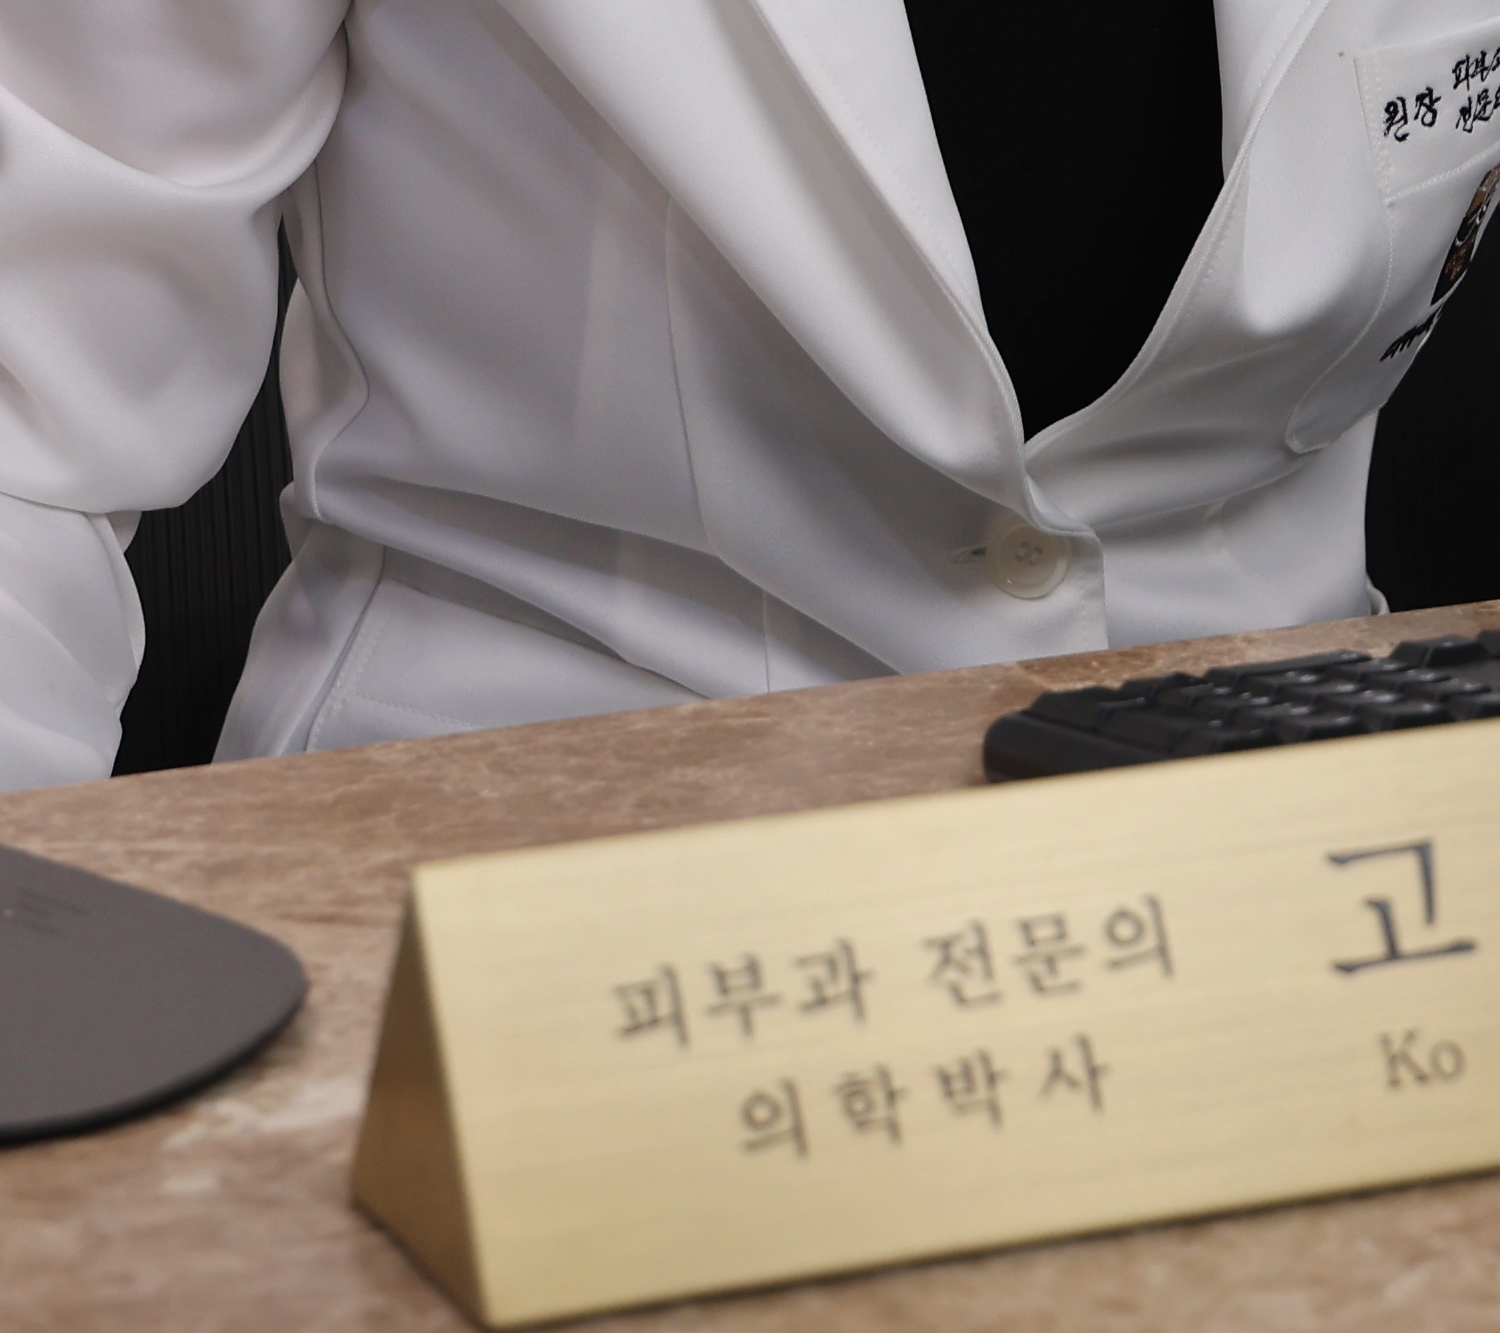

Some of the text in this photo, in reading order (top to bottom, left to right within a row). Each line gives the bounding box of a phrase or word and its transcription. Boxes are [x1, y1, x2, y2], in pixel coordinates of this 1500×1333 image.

[1384, 87, 1442, 142] 원장
[1327, 837, 1478, 976] 고
[612, 894, 1175, 1051] 피부과 전문의
[1380, 1030, 1466, 1089] Ko
